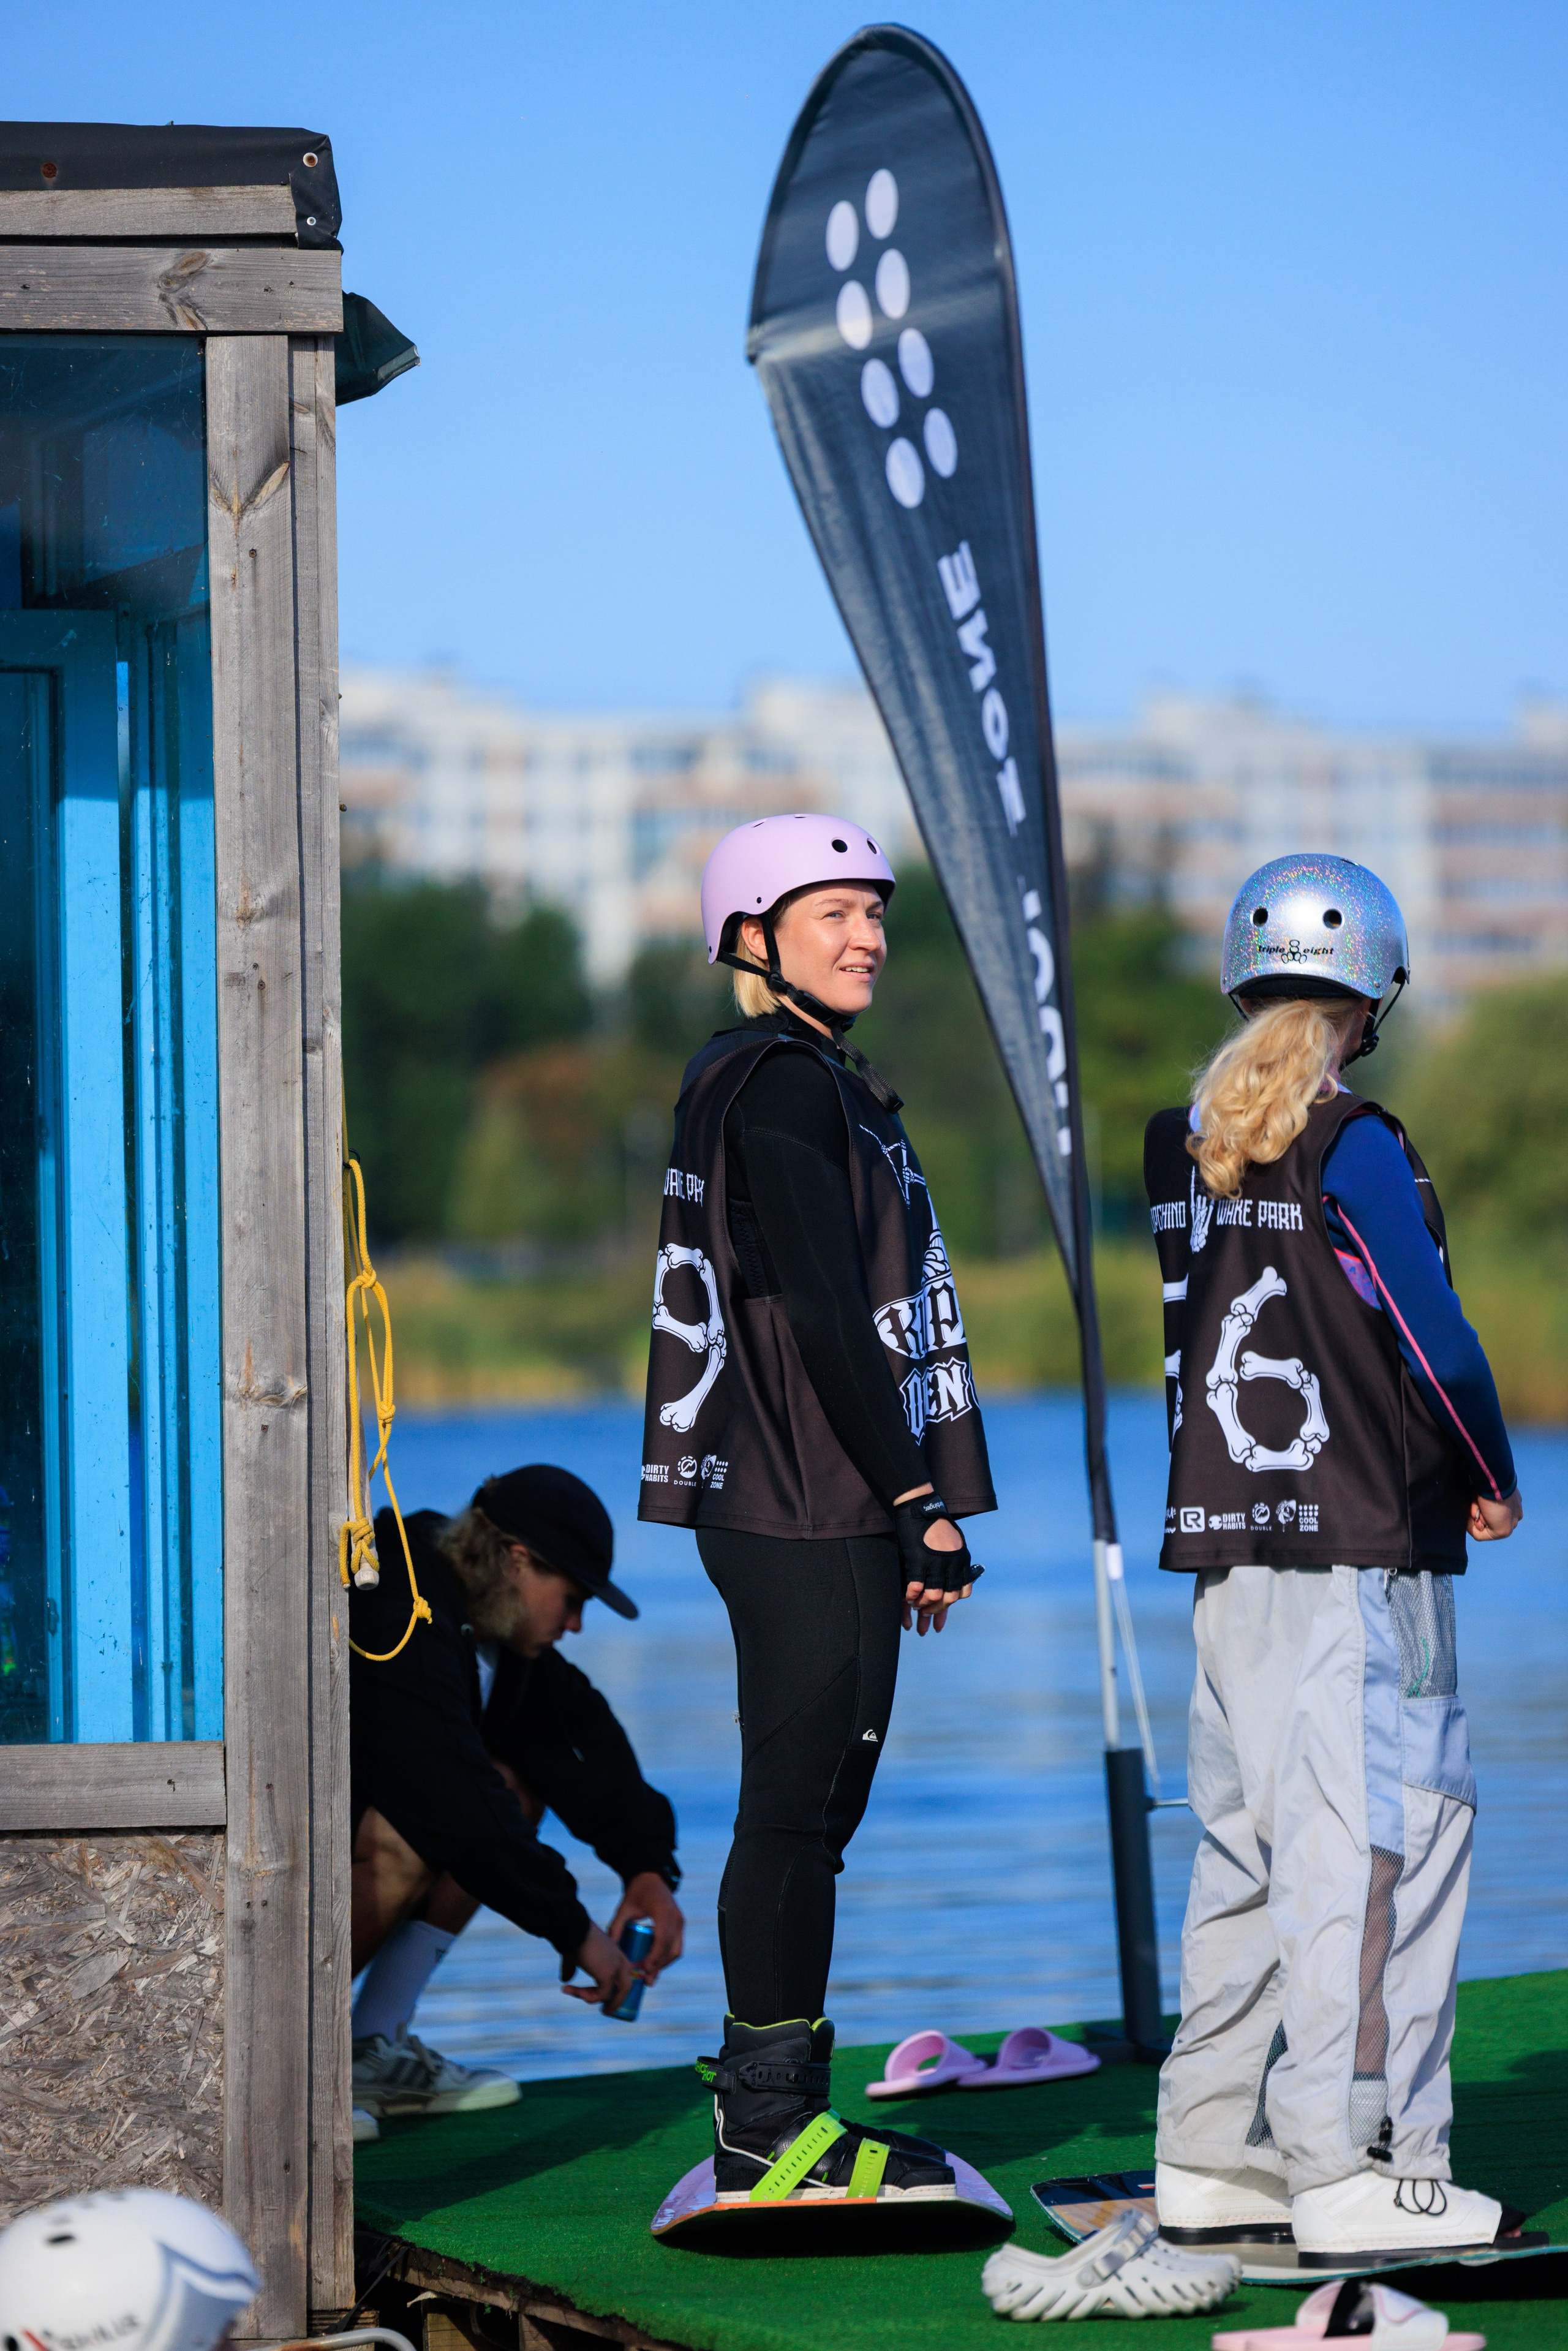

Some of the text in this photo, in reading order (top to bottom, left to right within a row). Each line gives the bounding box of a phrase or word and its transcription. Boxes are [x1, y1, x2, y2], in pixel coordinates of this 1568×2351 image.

[1258, 945, 1334, 955] triple eight
[1150, 1199, 1303, 1234] UPCHINO WAKE PARK
[652, 1243, 728, 1433] 9
[1206, 1266, 1330, 1471] 6
[646, 1464, 669, 1474] DIRTY
[645, 1474, 668, 1482] HABITS
[1222, 1513, 1246, 1523] DIRTY
